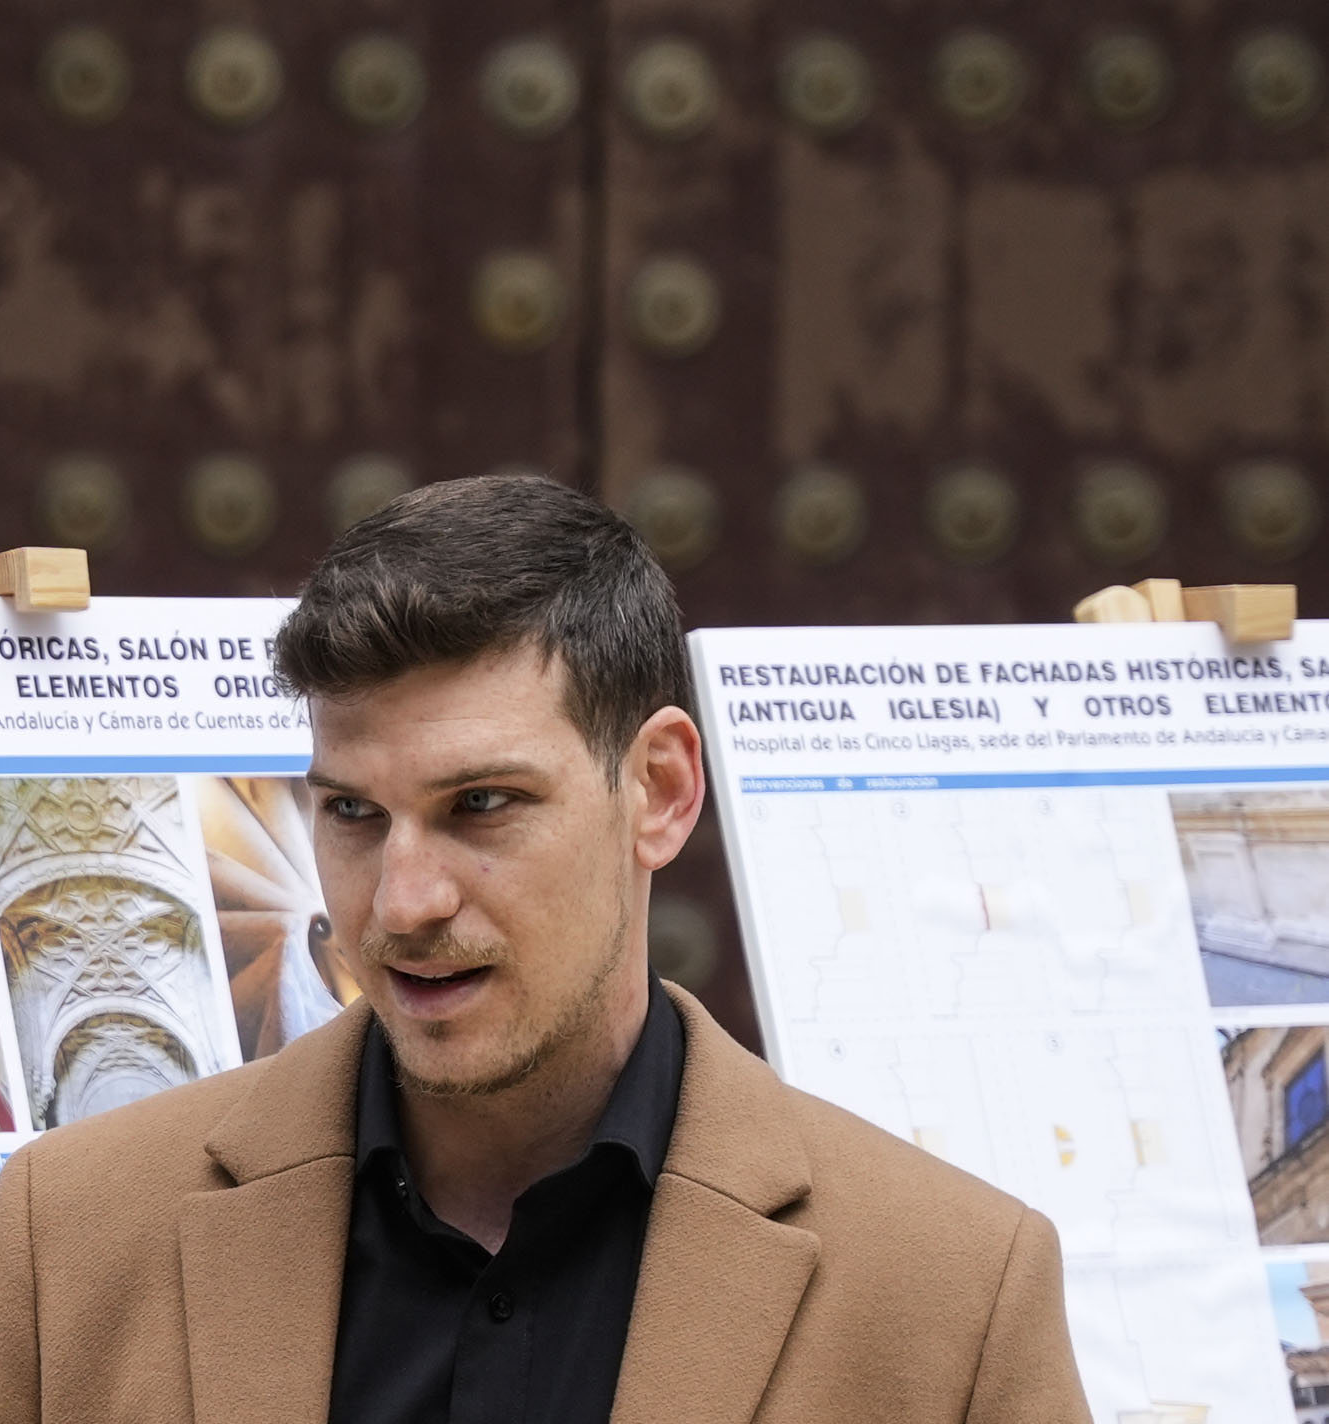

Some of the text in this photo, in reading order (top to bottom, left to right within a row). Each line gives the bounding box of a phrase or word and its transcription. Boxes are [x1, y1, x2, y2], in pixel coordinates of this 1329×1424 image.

[118, 630, 208, 660] SALÓN
[219, 638, 254, 660] DE
[719, 652, 1329, 686] RESTAURACIÓN DE FACHADAS HISTÓRICAS, SA
[16, 675, 180, 698] ELEMENTOS
[214, 675, 280, 698] ORIG
[85, 717, 94, 734] y
[99, 710, 163, 730] Cámara
[168, 711, 190, 730] de
[195, 712, 264, 730] Cuentas
[268, 711, 291, 730] de
[729, 691, 1329, 726] (ANTIGUA IGLESIA) Y OTROS ELEMENT
[734, 733, 805, 755] Hospital
[812, 735, 832, 751] de
[839, 735, 860, 751] las
[866, 733, 912, 751] Cinco
[918, 733, 975, 754] Llagas,
[980, 731, 1020, 749] sede
[1027, 729, 1051, 748] del
[1057, 728, 1150, 747] Parlamento
[1156, 727, 1175, 745] de
[1283, 725, 1329, 742] Cáma
